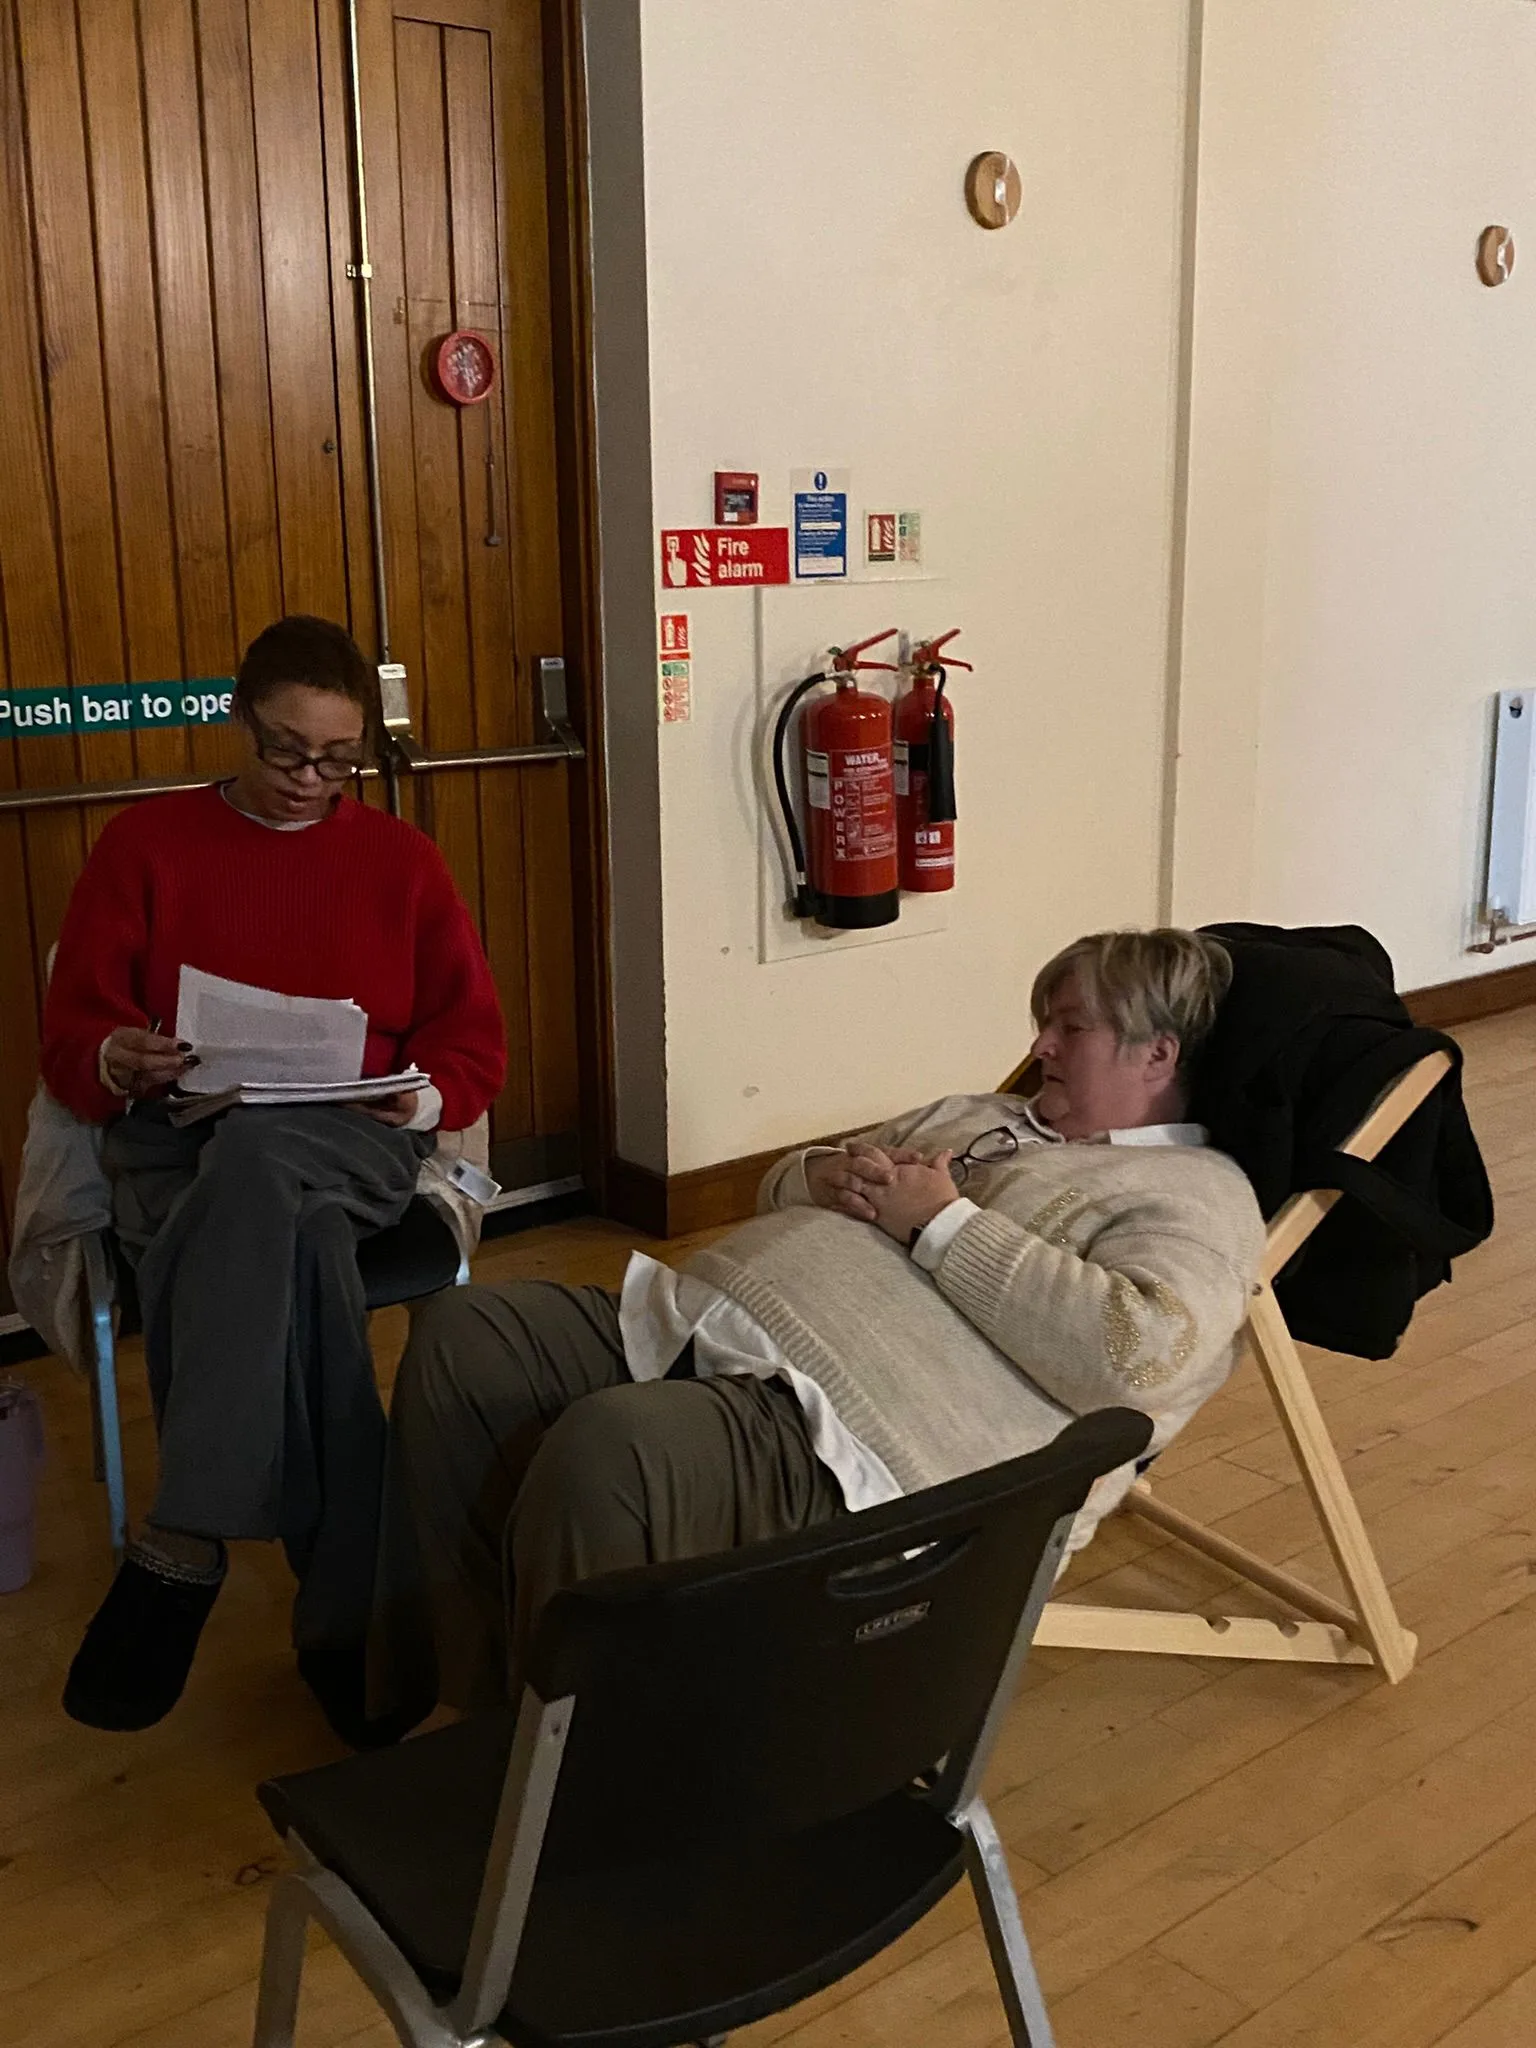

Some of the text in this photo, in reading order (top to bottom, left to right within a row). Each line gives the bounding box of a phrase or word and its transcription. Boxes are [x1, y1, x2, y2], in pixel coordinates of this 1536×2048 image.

[717, 536, 749, 557] Fire
[718, 560, 763, 578] alarm
[81, 695, 133, 723] bar
[141, 693, 173, 719] to
[181, 692, 233, 722] ope
[844, 752, 880, 767] WATER
